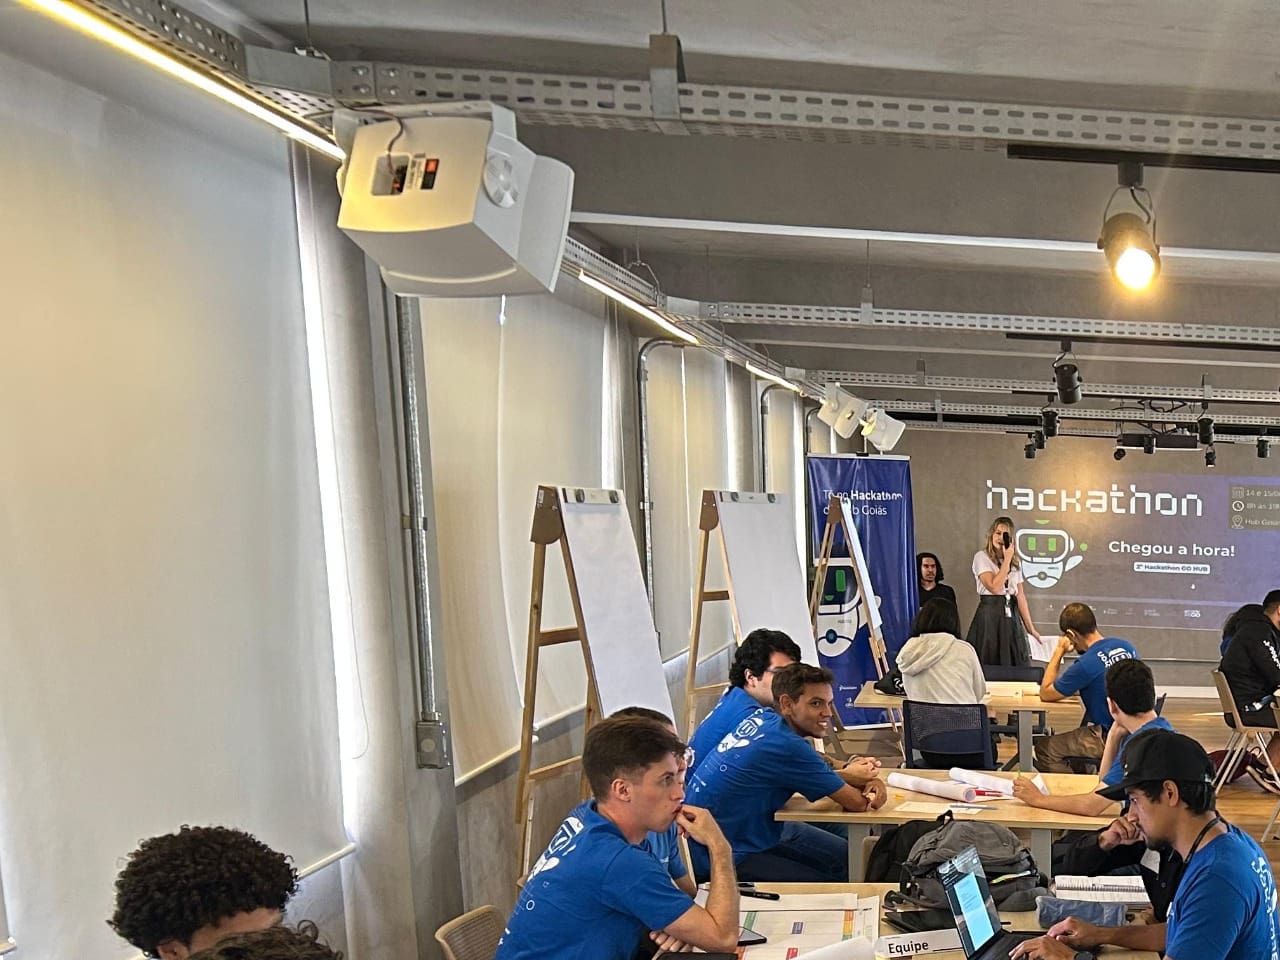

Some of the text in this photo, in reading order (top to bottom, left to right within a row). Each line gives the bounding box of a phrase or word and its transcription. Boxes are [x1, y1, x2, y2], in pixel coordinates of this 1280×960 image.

[986, 479, 1203, 517] hackathon
[861, 503, 888, 516] Goiás
[1108, 540, 1235, 557] Chegou a hora!
[1144, 564, 1180, 572] Hackathon
[888, 940, 929, 955] Equipe
